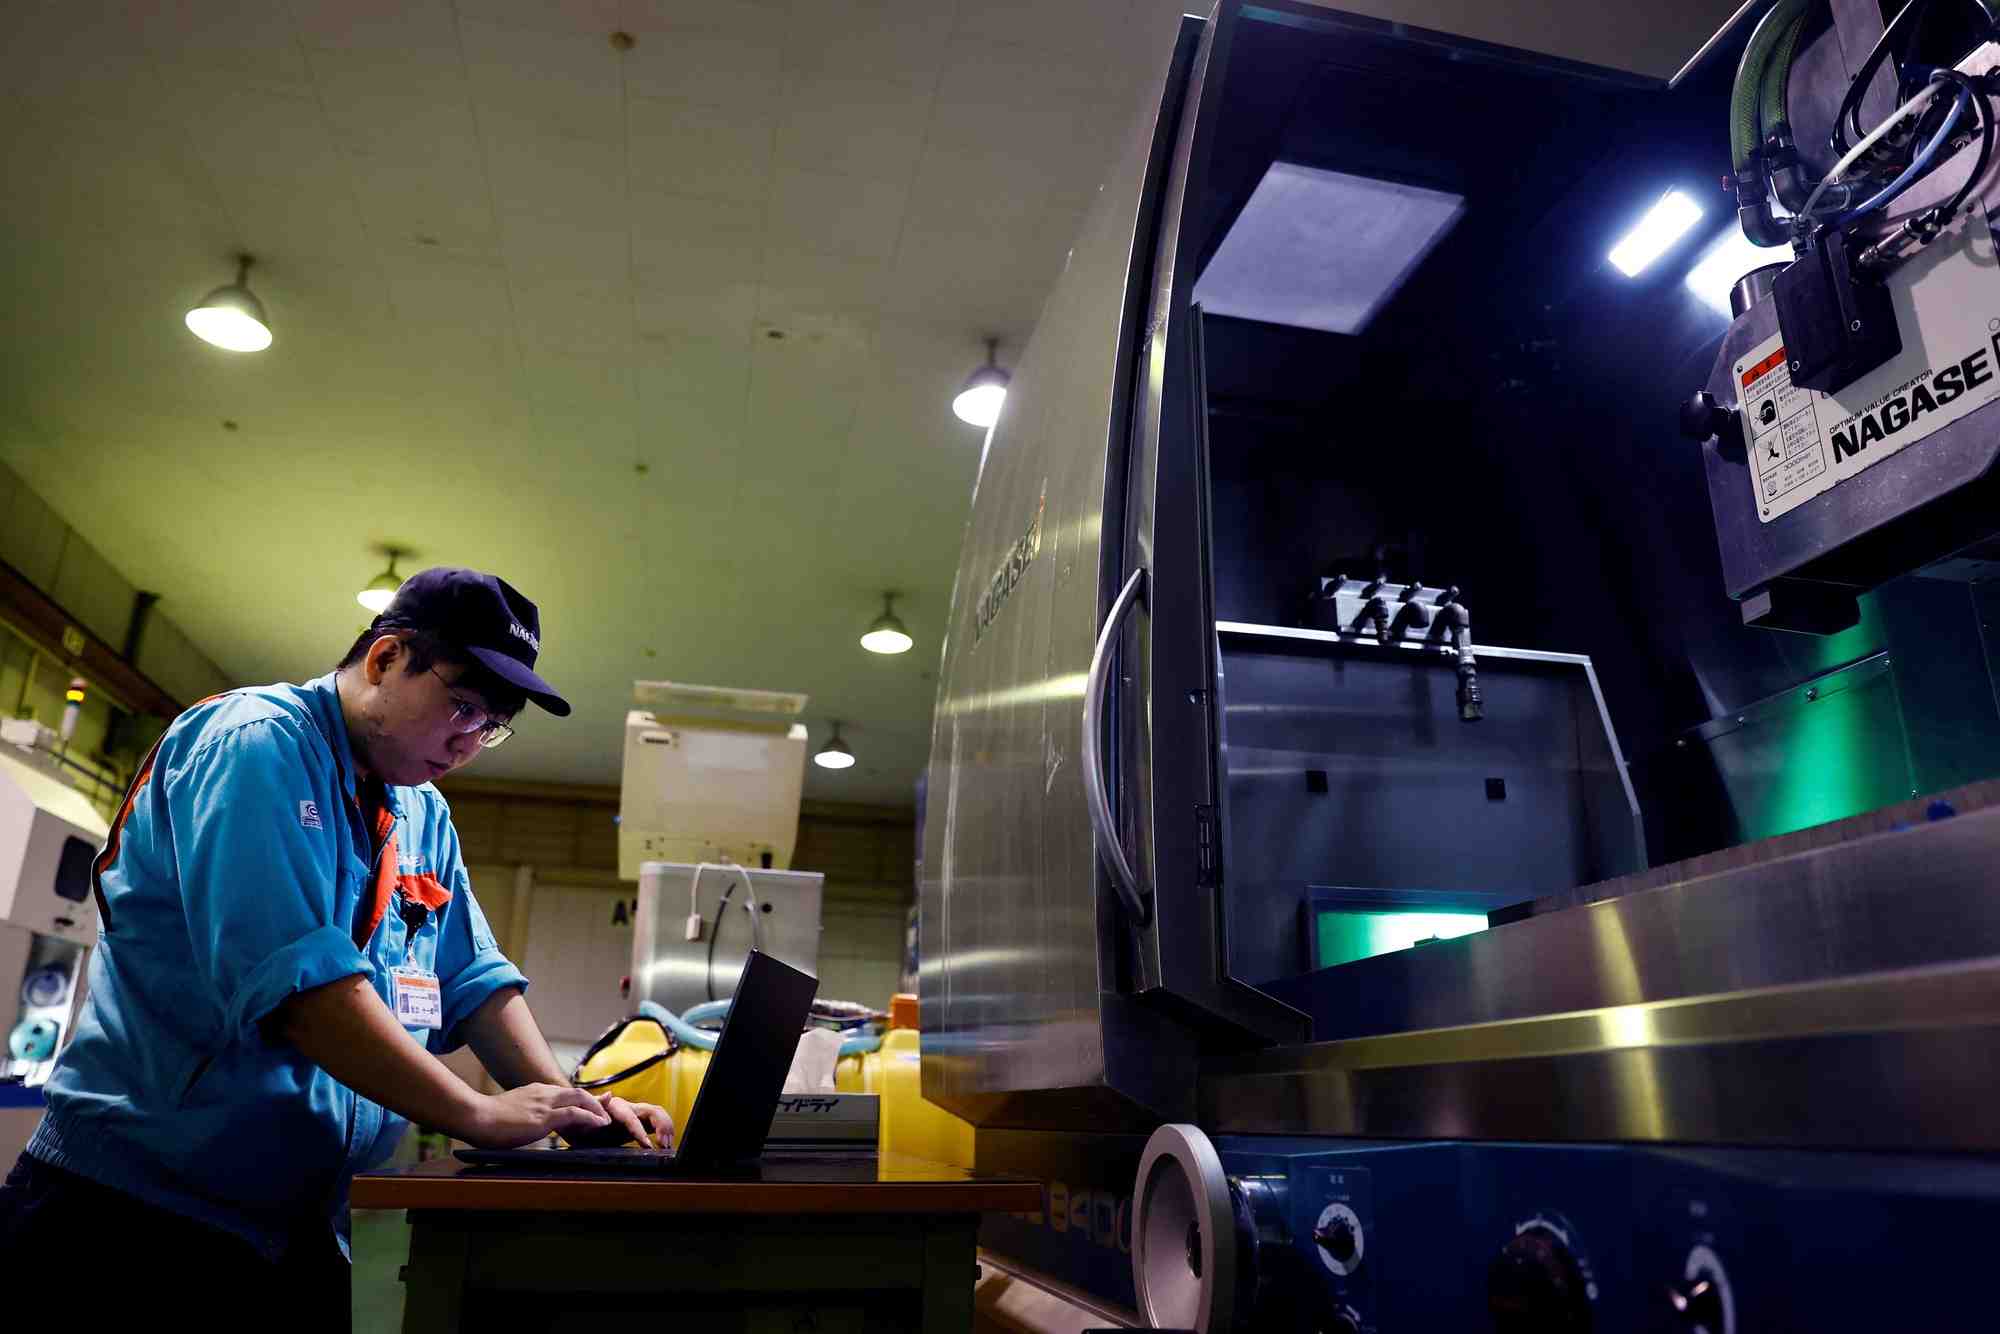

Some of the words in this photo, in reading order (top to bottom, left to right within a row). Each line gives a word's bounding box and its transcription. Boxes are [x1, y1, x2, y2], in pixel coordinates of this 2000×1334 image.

[1829, 410, 1864, 433] OPTIMUM
[1864, 393, 1891, 413] VALUE
[1893, 369, 1934, 397] CREATOR
[1831, 347, 1993, 464] NAGASE
[777, 1098, 840, 1113] イドライ
